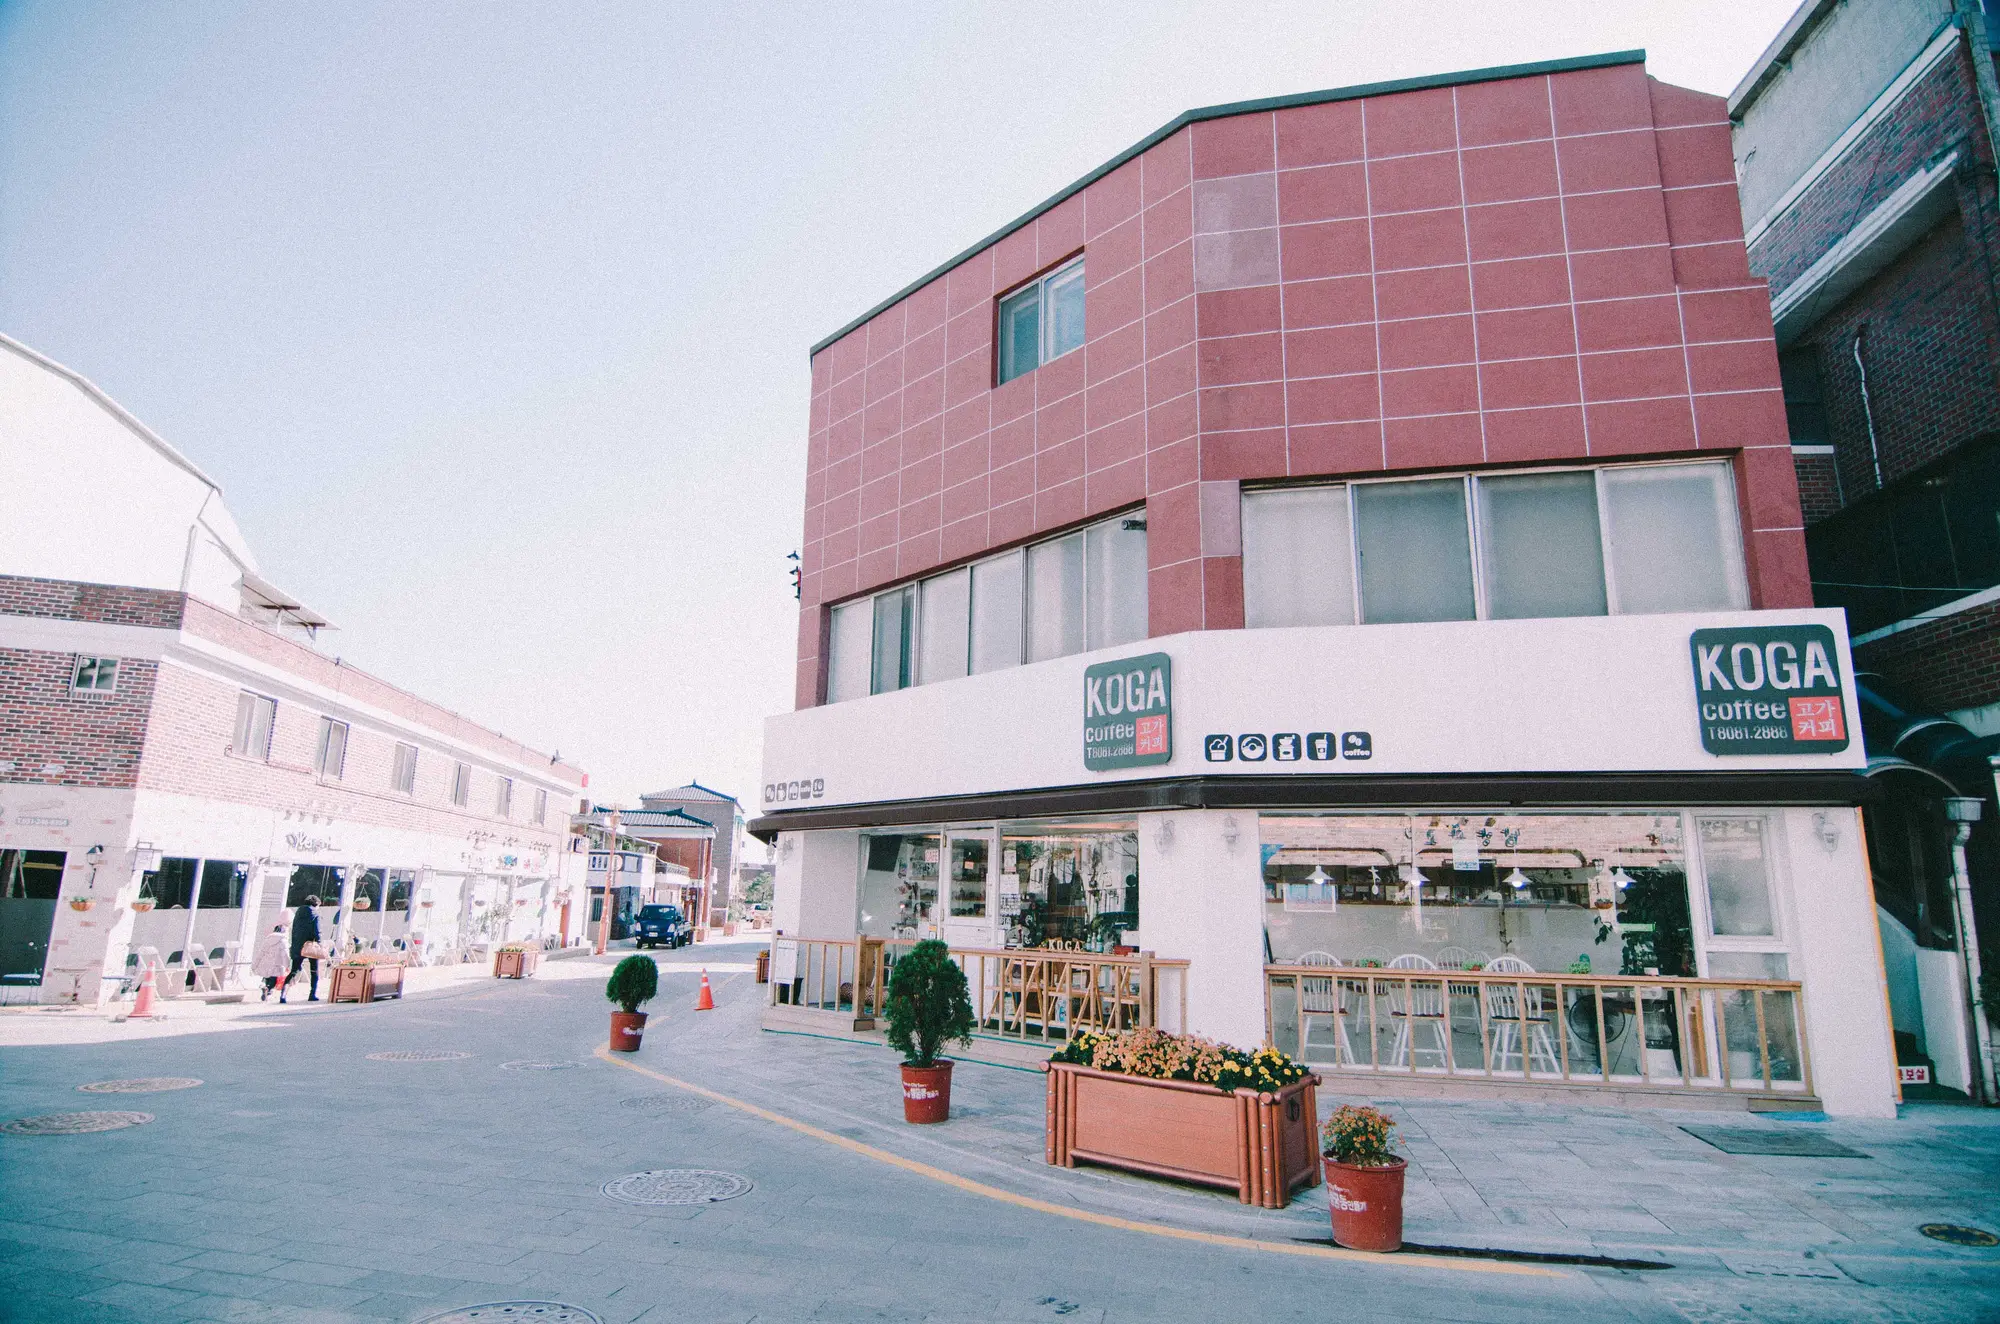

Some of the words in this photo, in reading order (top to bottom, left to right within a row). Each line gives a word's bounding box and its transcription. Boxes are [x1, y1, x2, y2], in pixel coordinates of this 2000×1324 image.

[1698, 640, 1838, 691] KOGA
[1087, 667, 1167, 718] KOGA
[1702, 700, 1787, 721] coffee
[1796, 699, 1836, 718] 고가
[1085, 722, 1135, 743] coffee
[1798, 719, 1837, 737] 커피
[1344, 748, 1370, 756] coffee
[1048, 939, 1081, 952] KOGA
